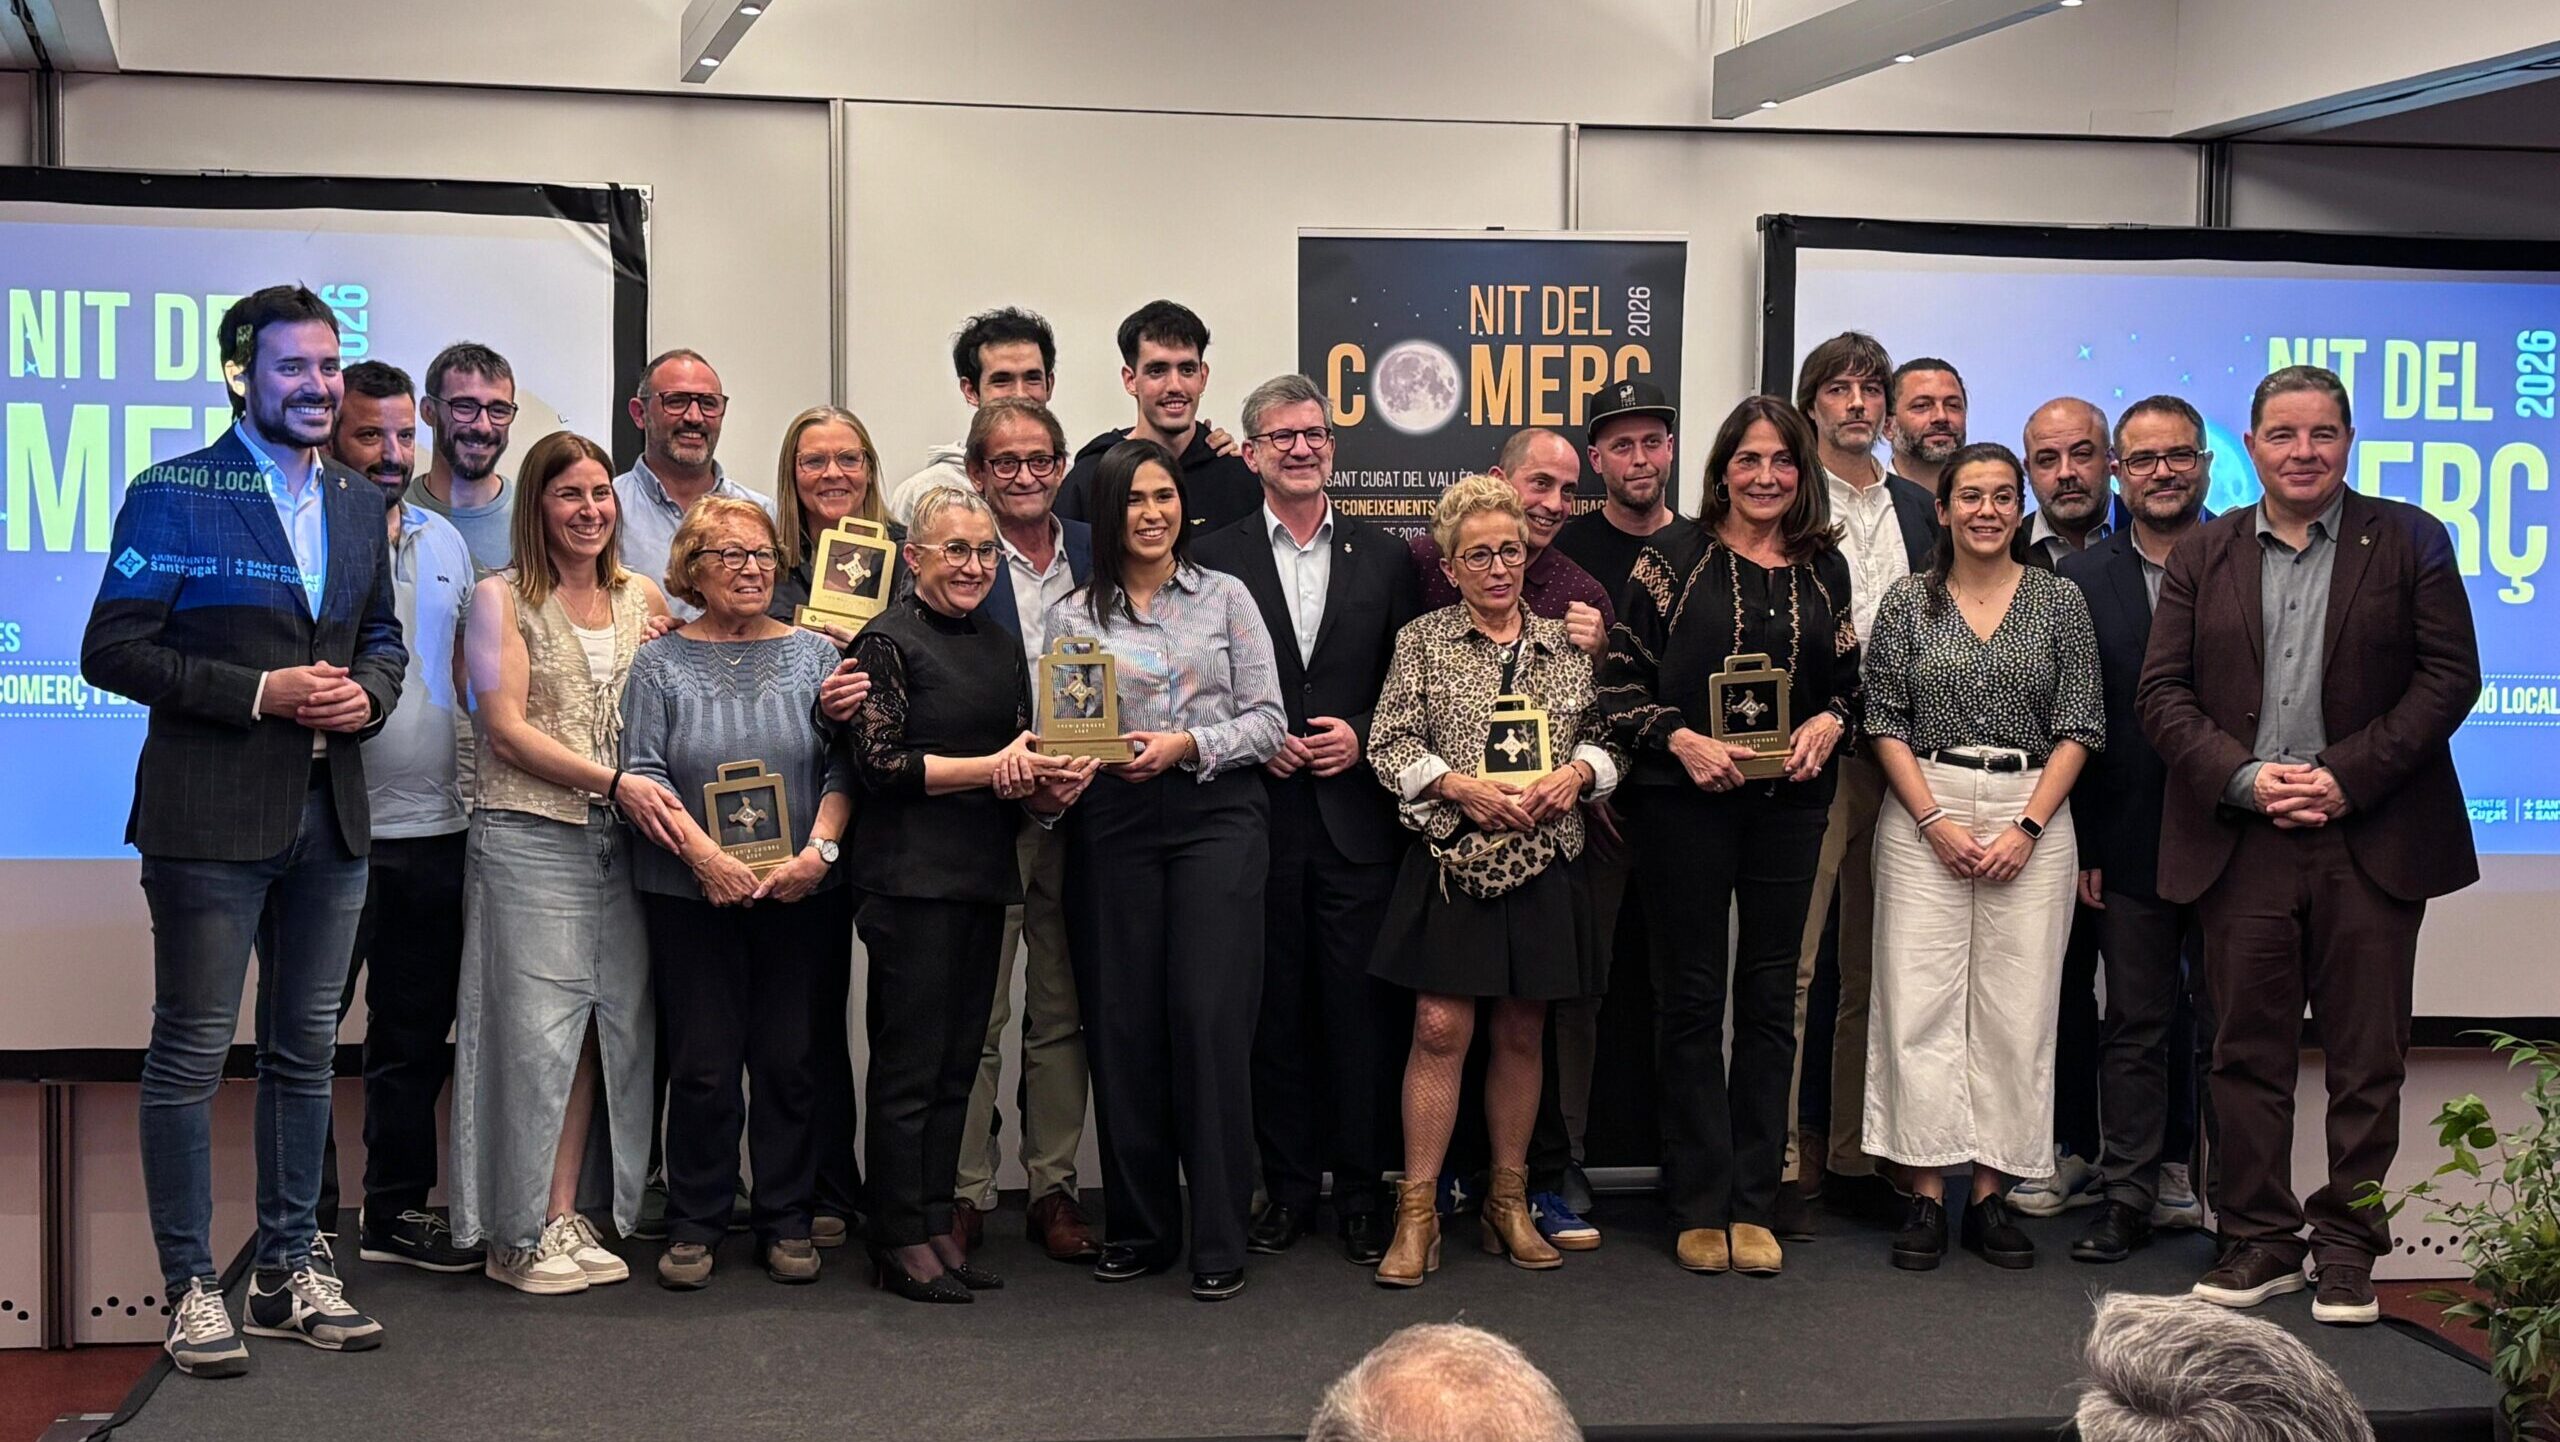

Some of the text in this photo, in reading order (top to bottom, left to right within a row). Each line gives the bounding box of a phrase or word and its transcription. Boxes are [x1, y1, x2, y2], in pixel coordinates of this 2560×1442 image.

[9, 287, 246, 383] NIT DE
[320, 284, 369, 368] 026
[1470, 284, 1613, 336] NIT DEL
[1627, 286, 1651, 337] 2026
[2383, 339, 2494, 422] DEL
[2515, 330, 2557, 418] 2026
[1326, 470, 1358, 487] SANT
[1360, 470, 1401, 488] CUGAT
[1403, 471, 1425, 487] DEL
[247, 560, 278, 573] SANT
[247, 569, 278, 582] SANT
[0, 674, 88, 711] OMERÇ
[2501, 686, 2560, 714] LOCAL
